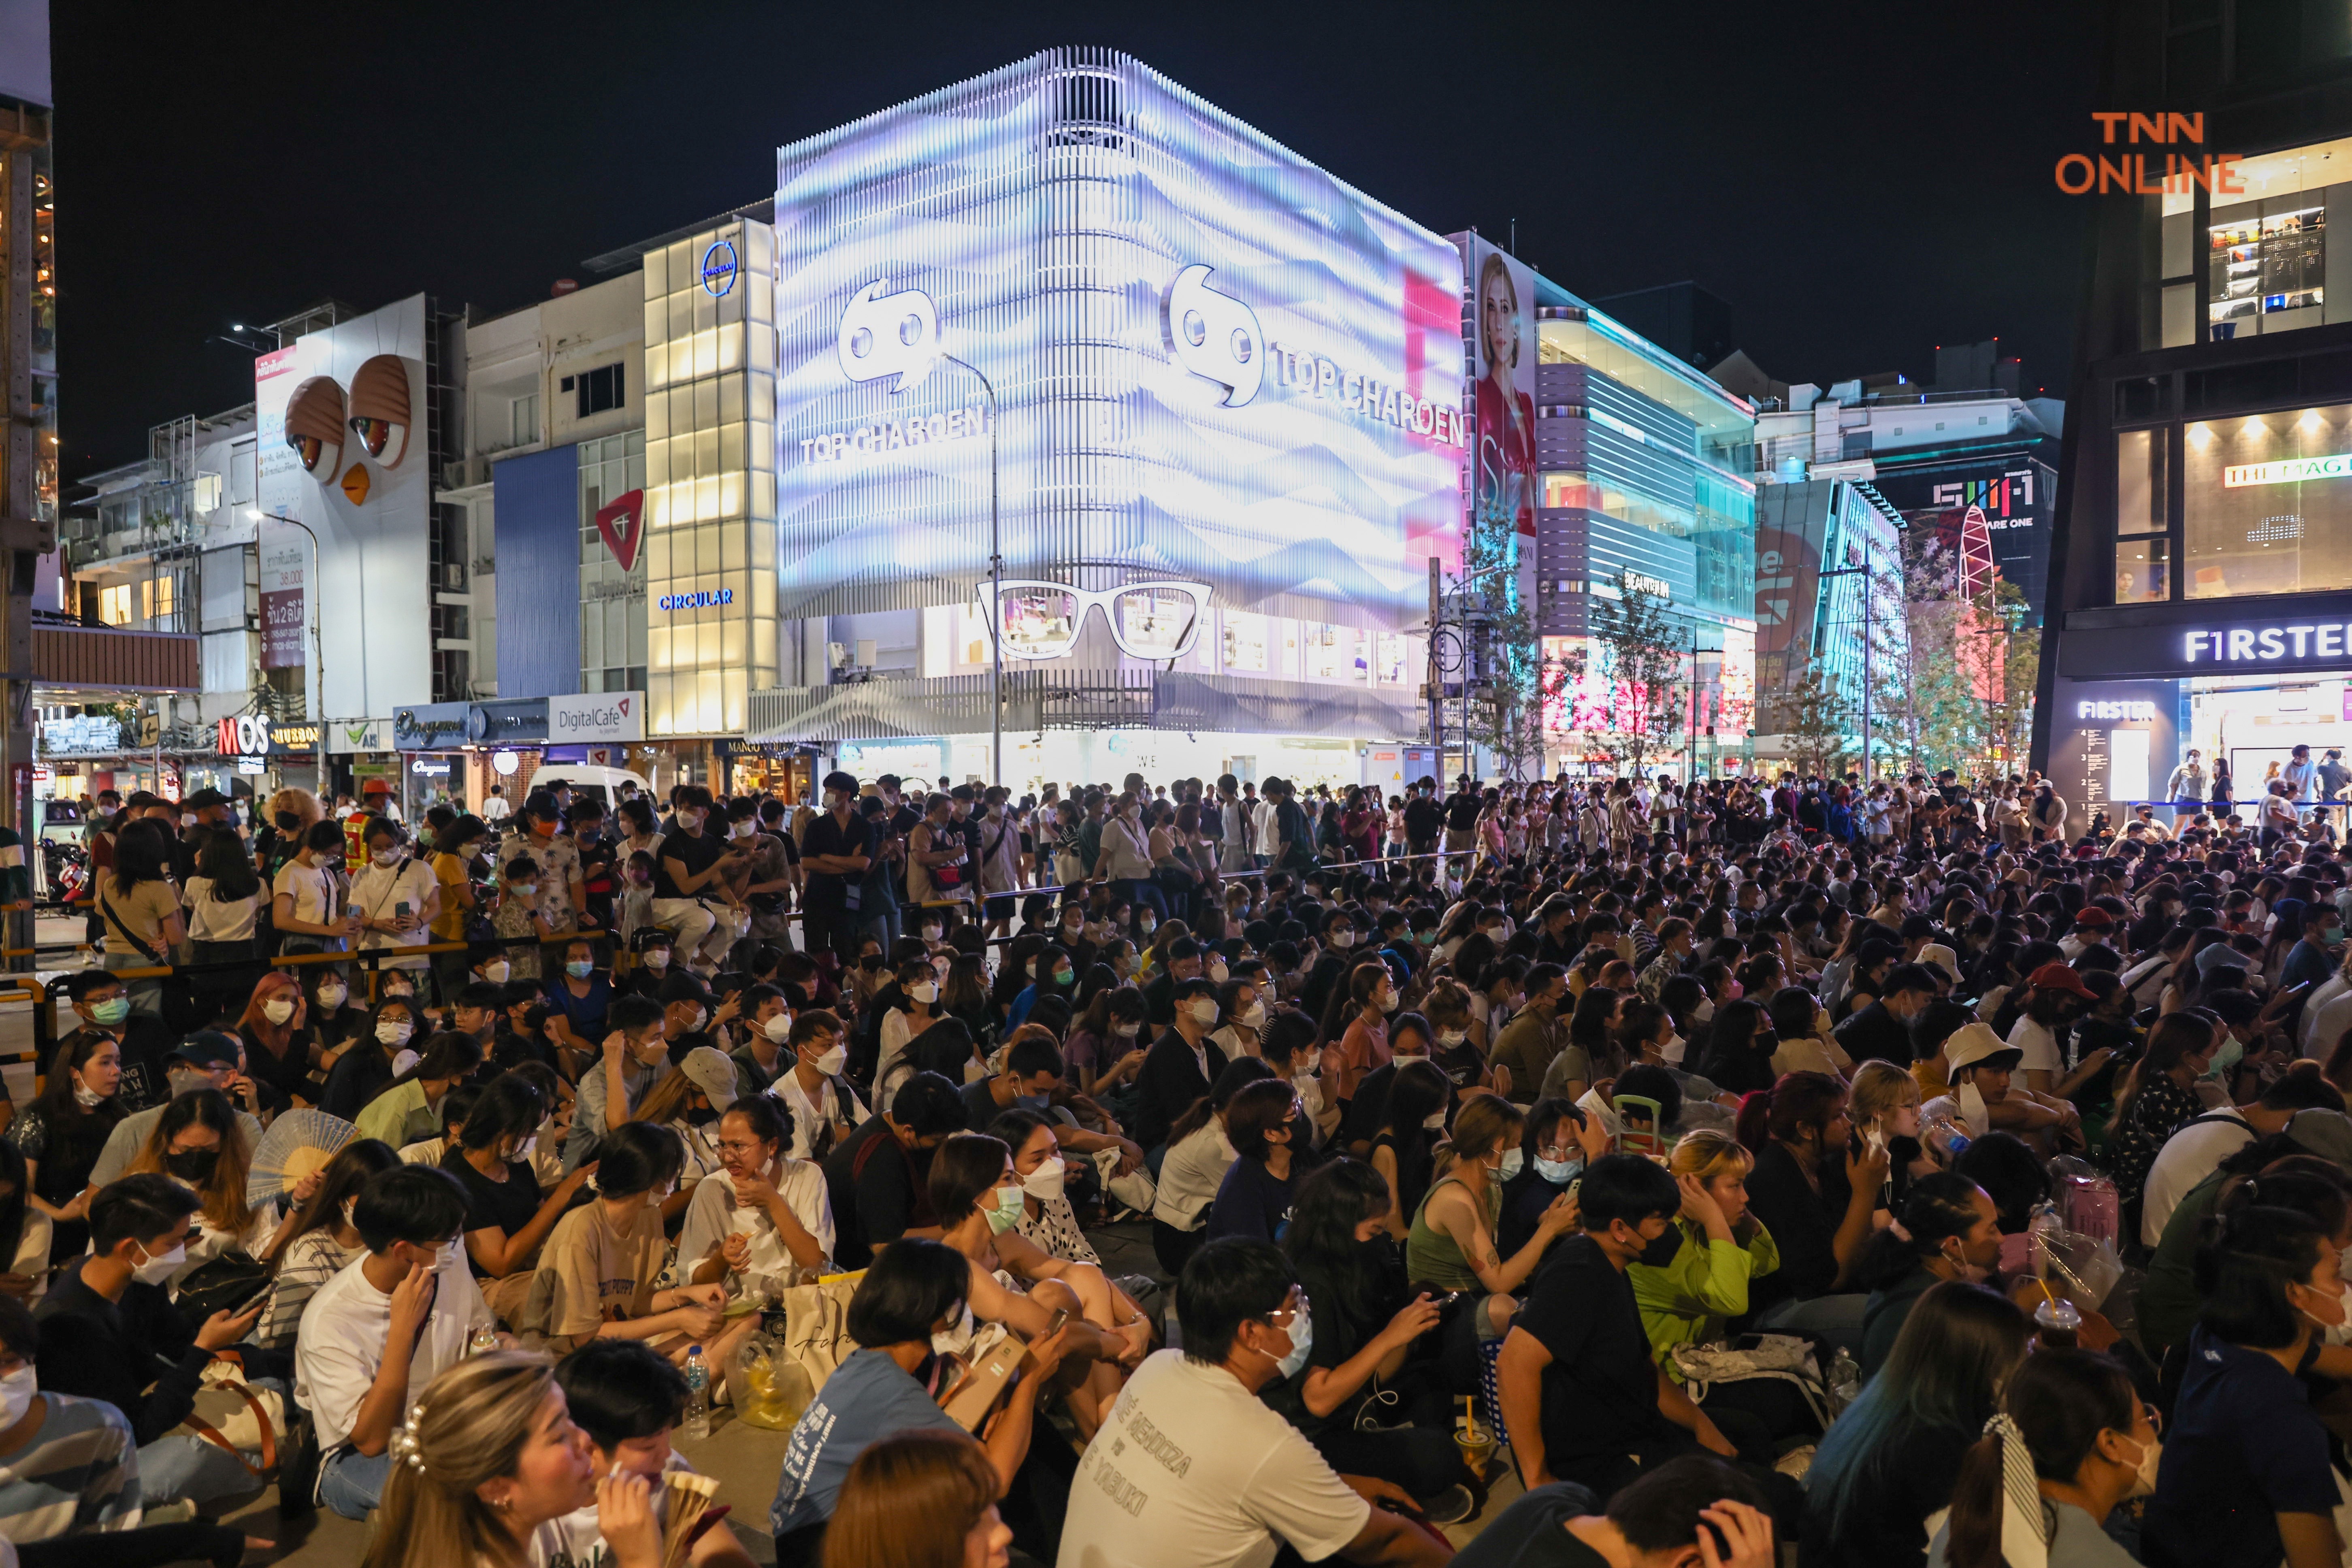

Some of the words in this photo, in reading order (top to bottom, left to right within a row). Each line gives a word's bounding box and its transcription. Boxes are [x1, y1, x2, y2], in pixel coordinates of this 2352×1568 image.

[705, 262, 733, 277] CIRCULAR
[1272, 341, 1335, 398] TOP
[1340, 369, 1464, 448] CHAROEN
[801, 434, 846, 465] TOP
[853, 405, 984, 454] CHAROEN
[2009, 517, 2033, 527] ONE
[658, 588, 733, 611] CIRCULAR
[218, 714, 271, 755] MOS
[559, 708, 620, 731] DigitalCafe
[1126, 1411, 1192, 1479] MENDOZA
[1093, 1456, 1148, 1518] YABUKI
